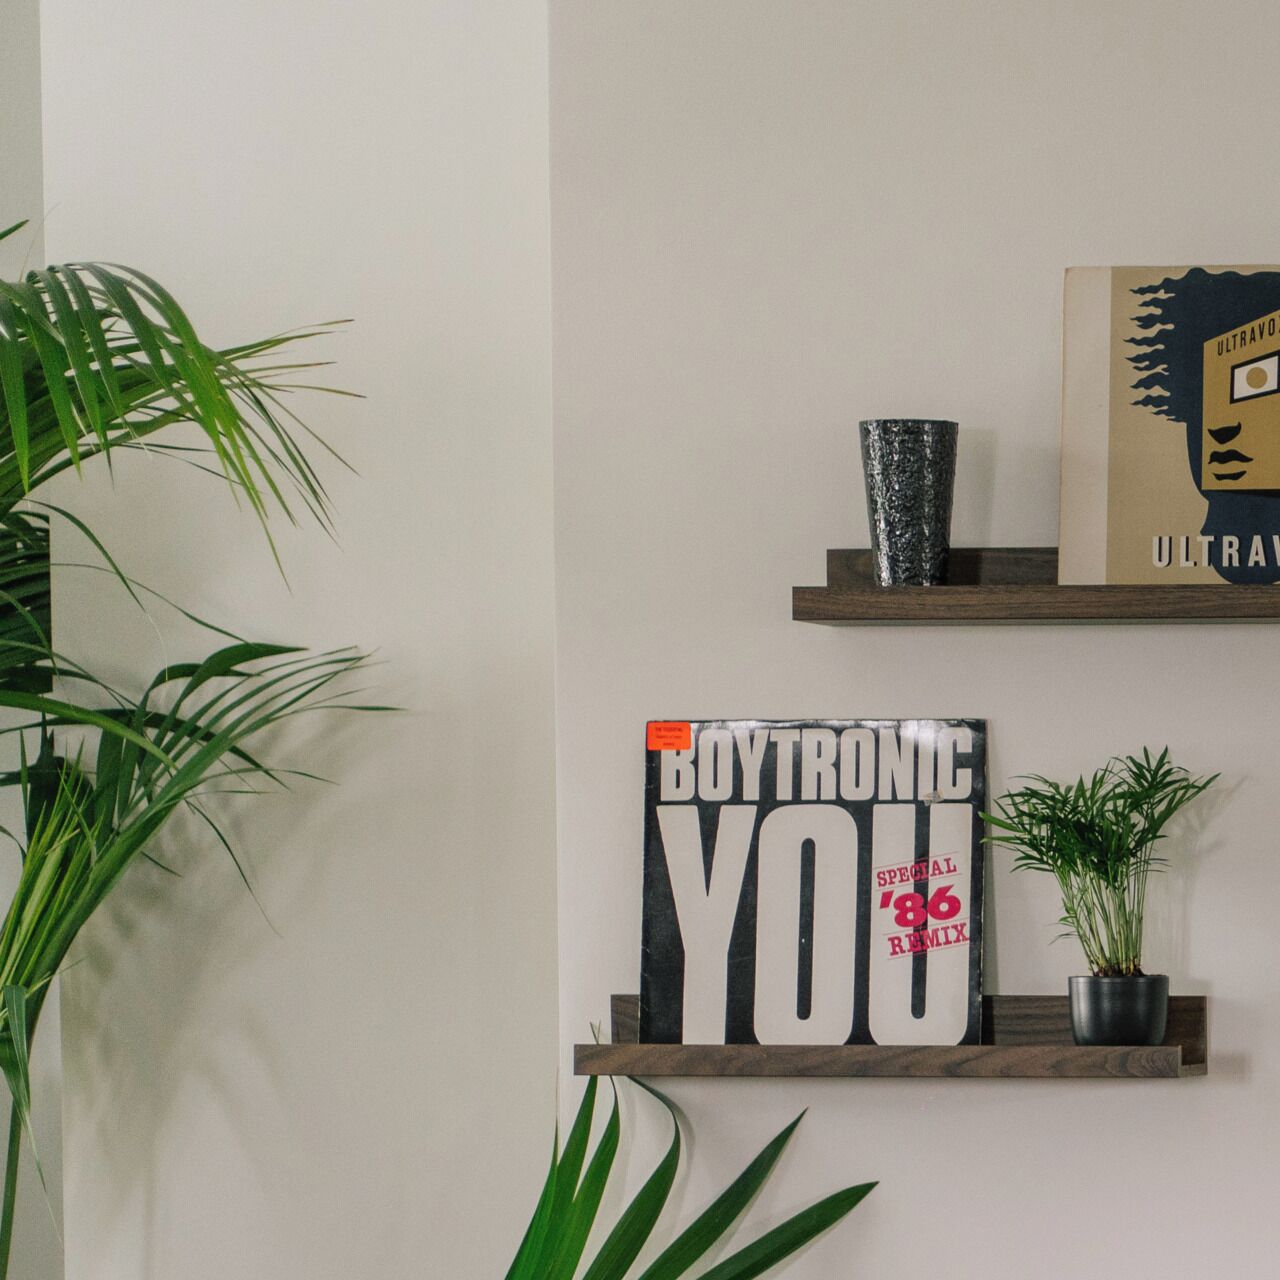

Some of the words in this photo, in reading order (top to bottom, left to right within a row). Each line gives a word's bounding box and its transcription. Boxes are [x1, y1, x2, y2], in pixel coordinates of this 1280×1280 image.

[660, 727, 973, 801] BOYTRONIC
[876, 857, 957, 888] SPECIAL
[655, 802, 974, 1046] YOU
[879, 884, 962, 928] '86
[887, 922, 970, 956] REMIX
